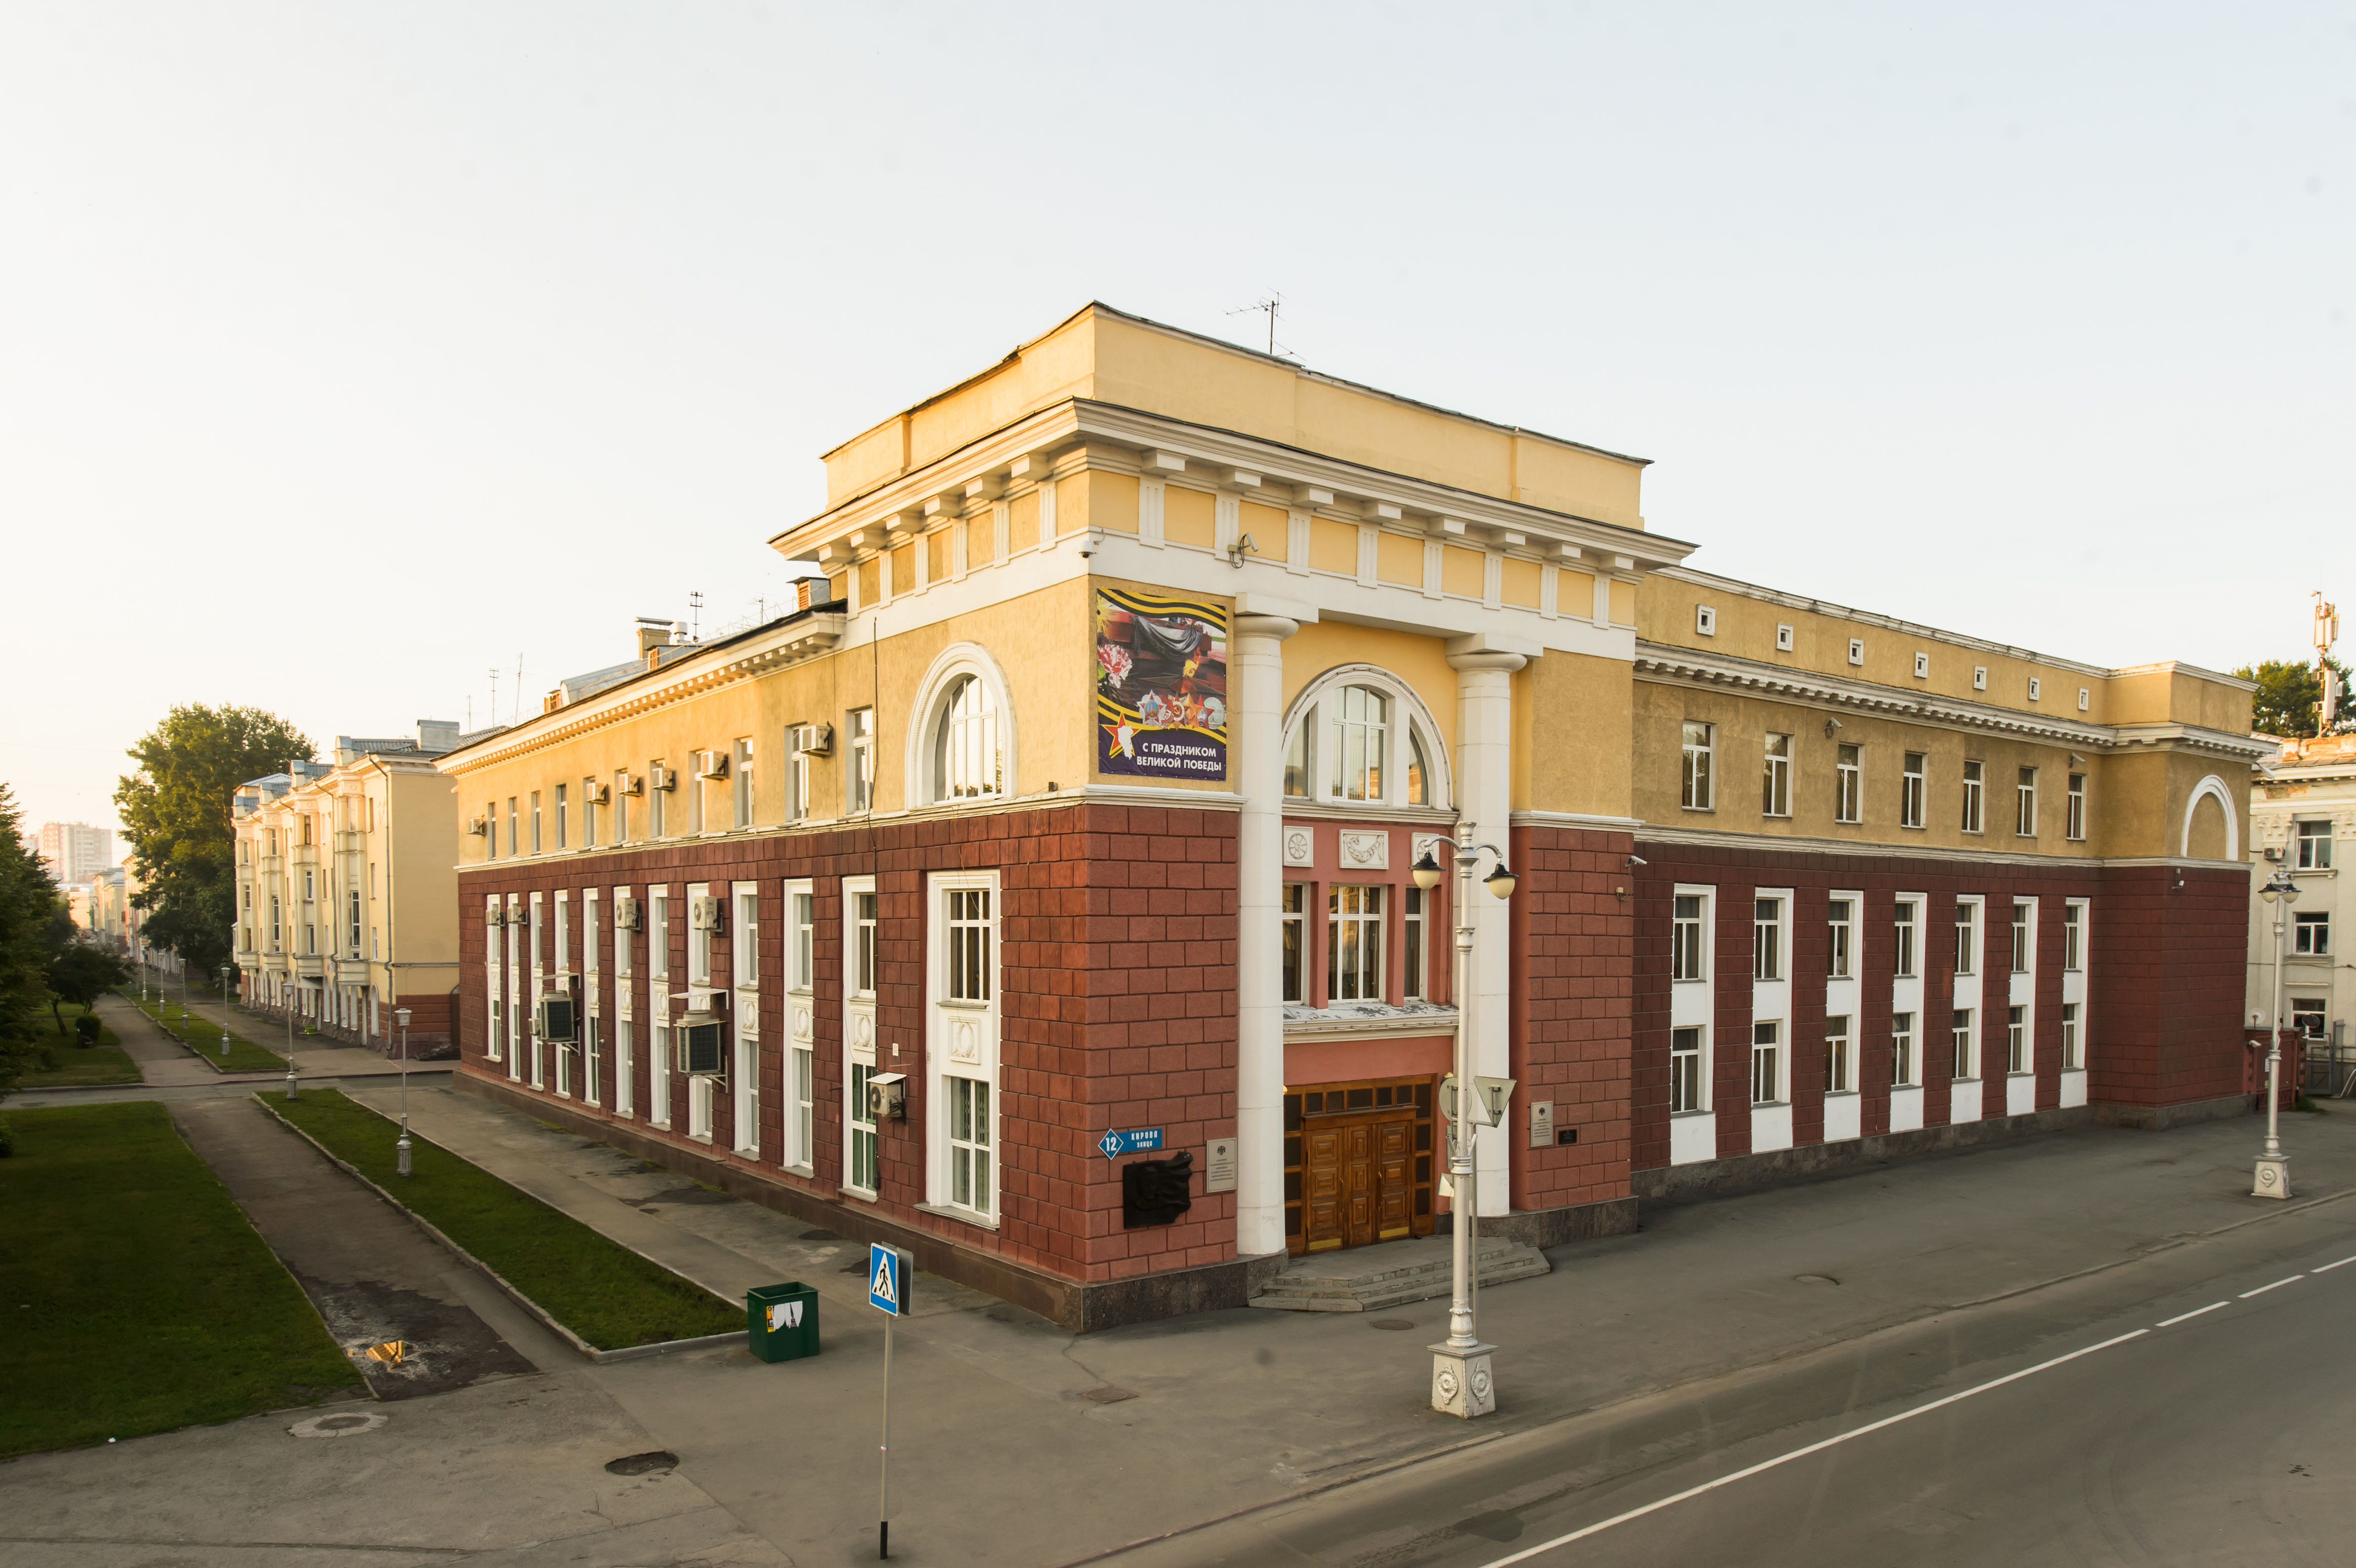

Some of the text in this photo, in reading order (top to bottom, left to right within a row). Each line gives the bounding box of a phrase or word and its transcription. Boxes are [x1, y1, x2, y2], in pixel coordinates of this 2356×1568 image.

[1142, 742, 1217, 757] С ПРАЗДНИКОМ
[1136, 756, 1222, 772] ВЕЛИКОЙ ПОБЕДЫ
[1131, 1130, 1158, 1141] КИРОВА
[1105, 1136, 1117, 1152] 12
